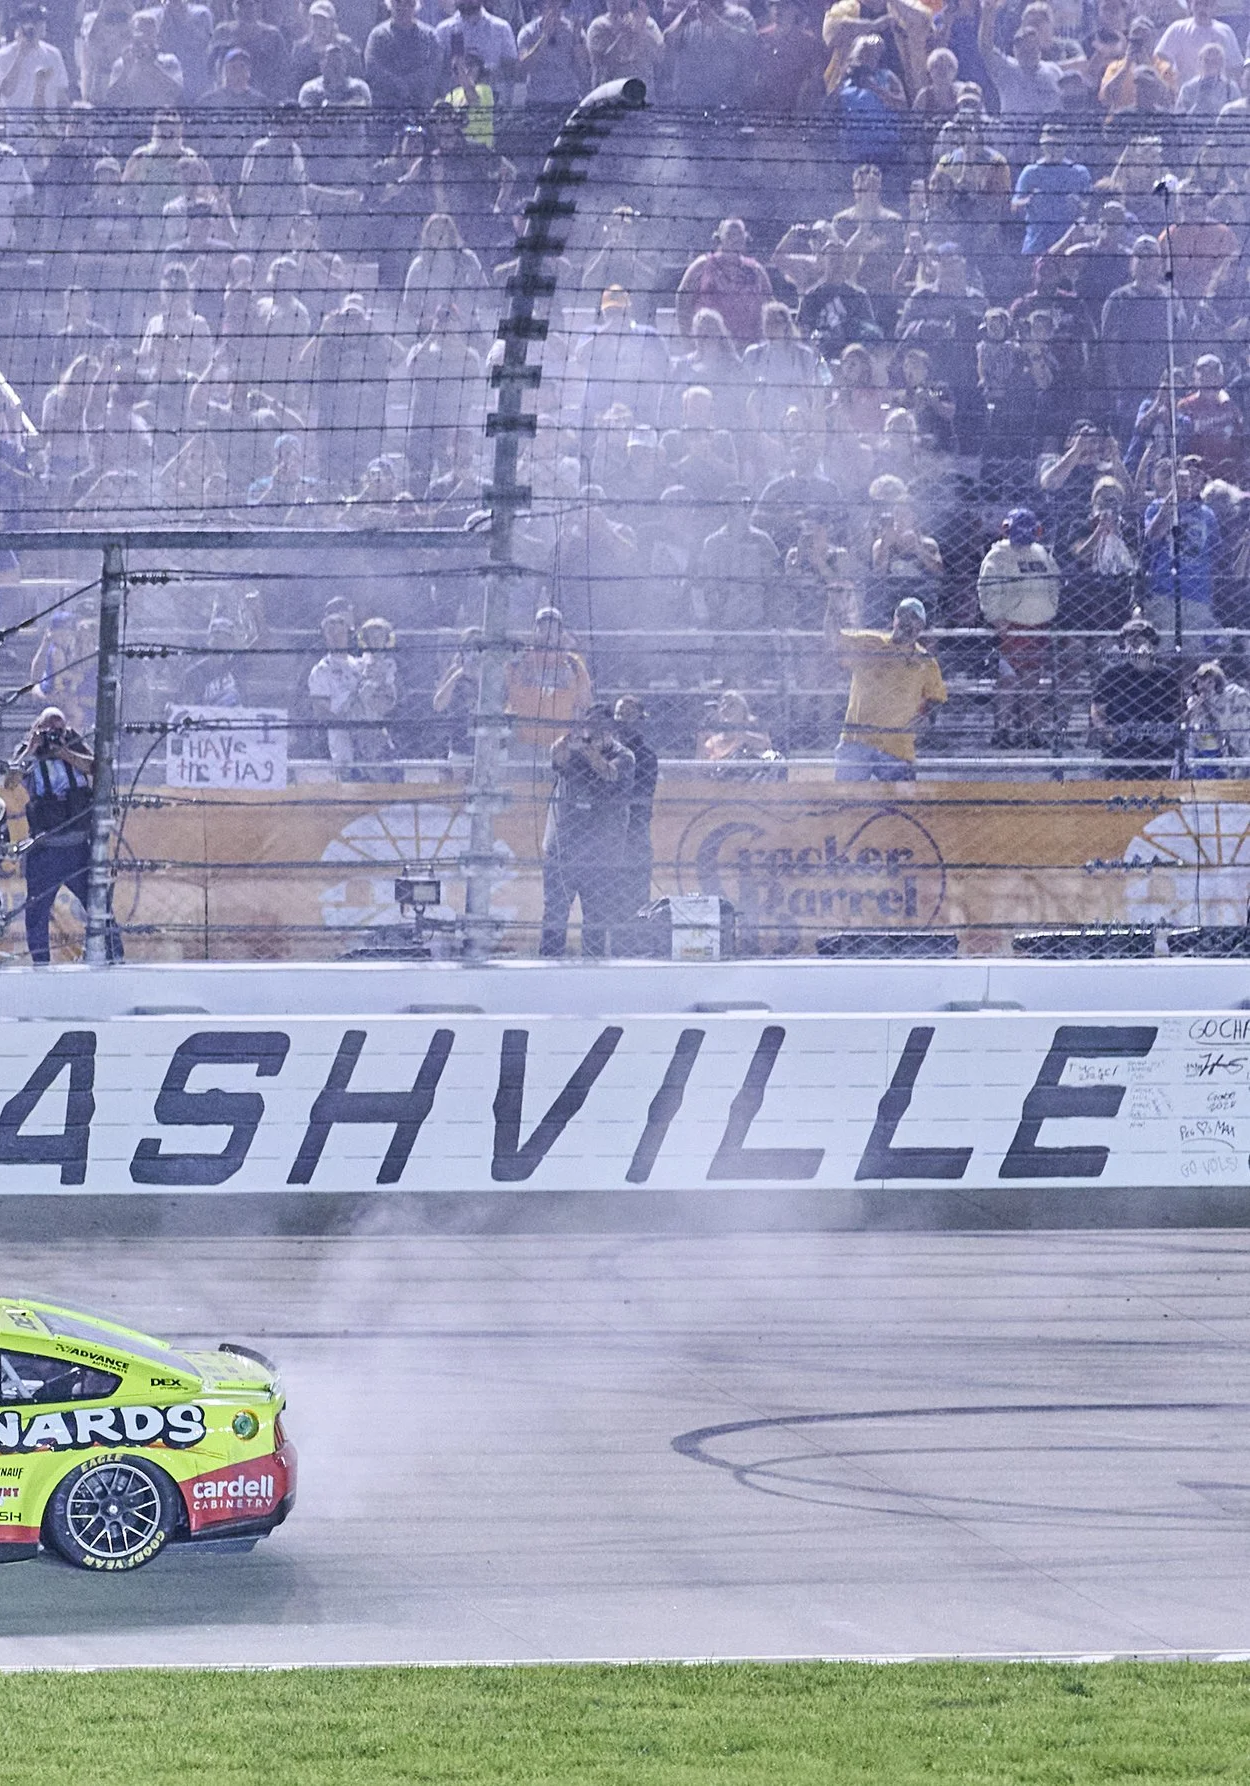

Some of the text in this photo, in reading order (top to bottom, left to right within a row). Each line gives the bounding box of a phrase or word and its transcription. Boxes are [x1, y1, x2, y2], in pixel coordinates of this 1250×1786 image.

[70, 1348, 130, 1370] ADVANCE
[80, 1453, 124, 1473] EAGLE
[192, 1475, 274, 1499] cardell
[193, 1499, 273, 1511] CABINETRY
